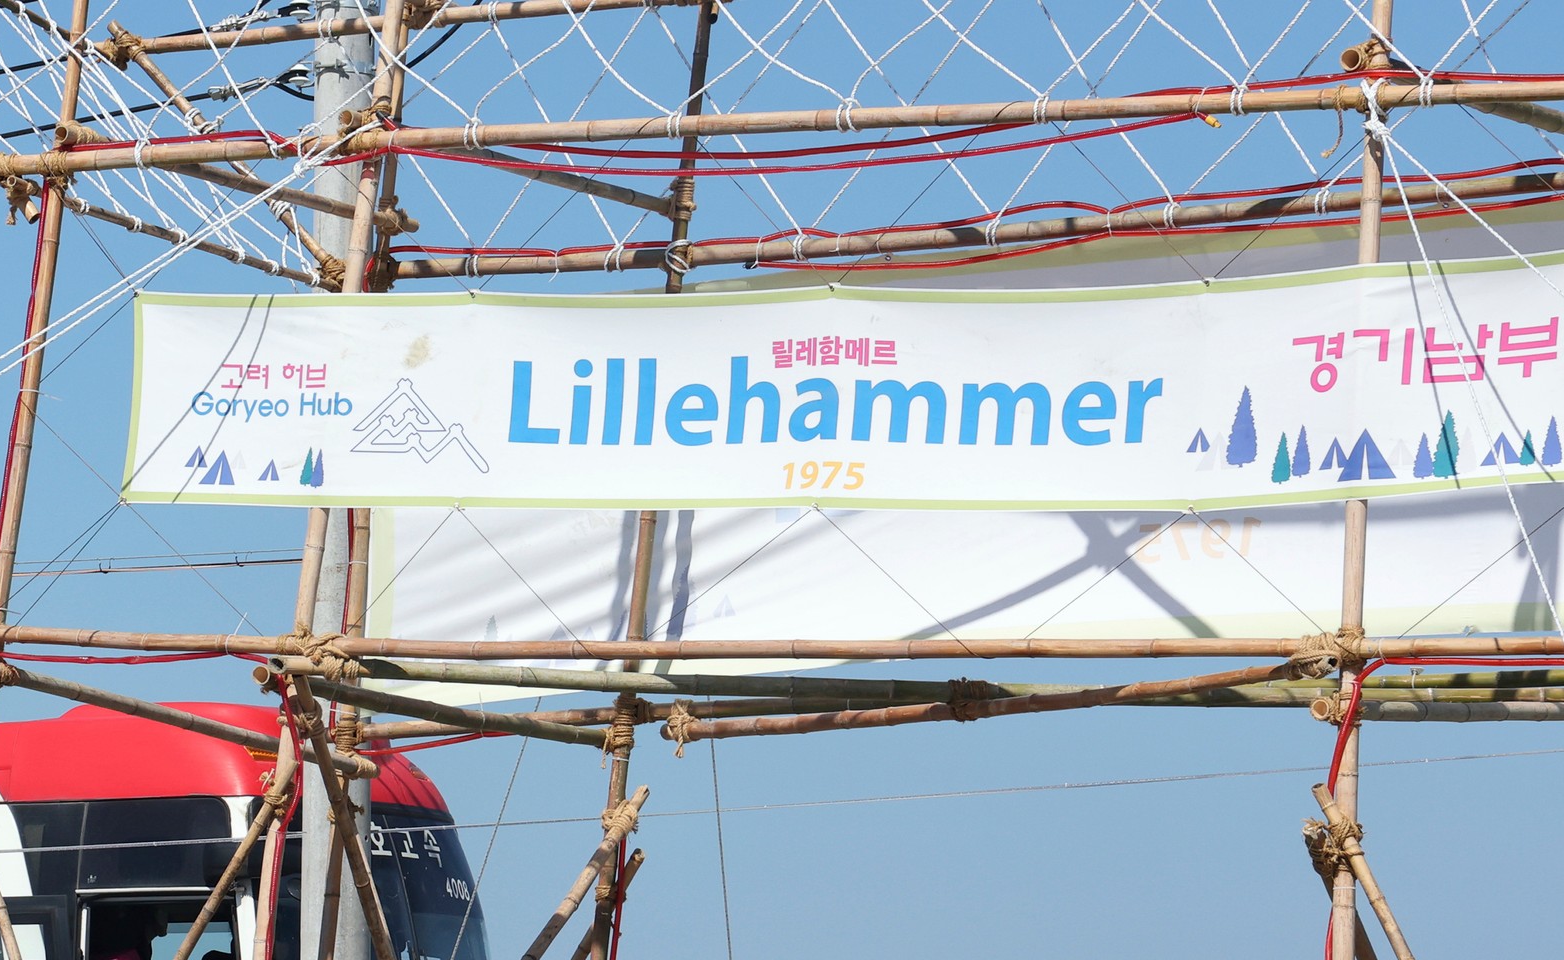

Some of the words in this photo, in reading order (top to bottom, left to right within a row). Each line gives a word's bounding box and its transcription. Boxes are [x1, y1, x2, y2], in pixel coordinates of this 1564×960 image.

[771, 336, 898, 370] 릴레함메르
[1292, 316, 1560, 393] 경기남부
[220, 363, 269, 390] 고려
[282, 363, 327, 389] 허브
[191, 392, 290, 423] Goryeo
[299, 392, 353, 416] Hub
[508, 355, 1164, 446] Lillehammer
[782, 460, 866, 490] 1975
[371, 821, 443, 868] 호고속
[445, 877, 471, 901] 4008
